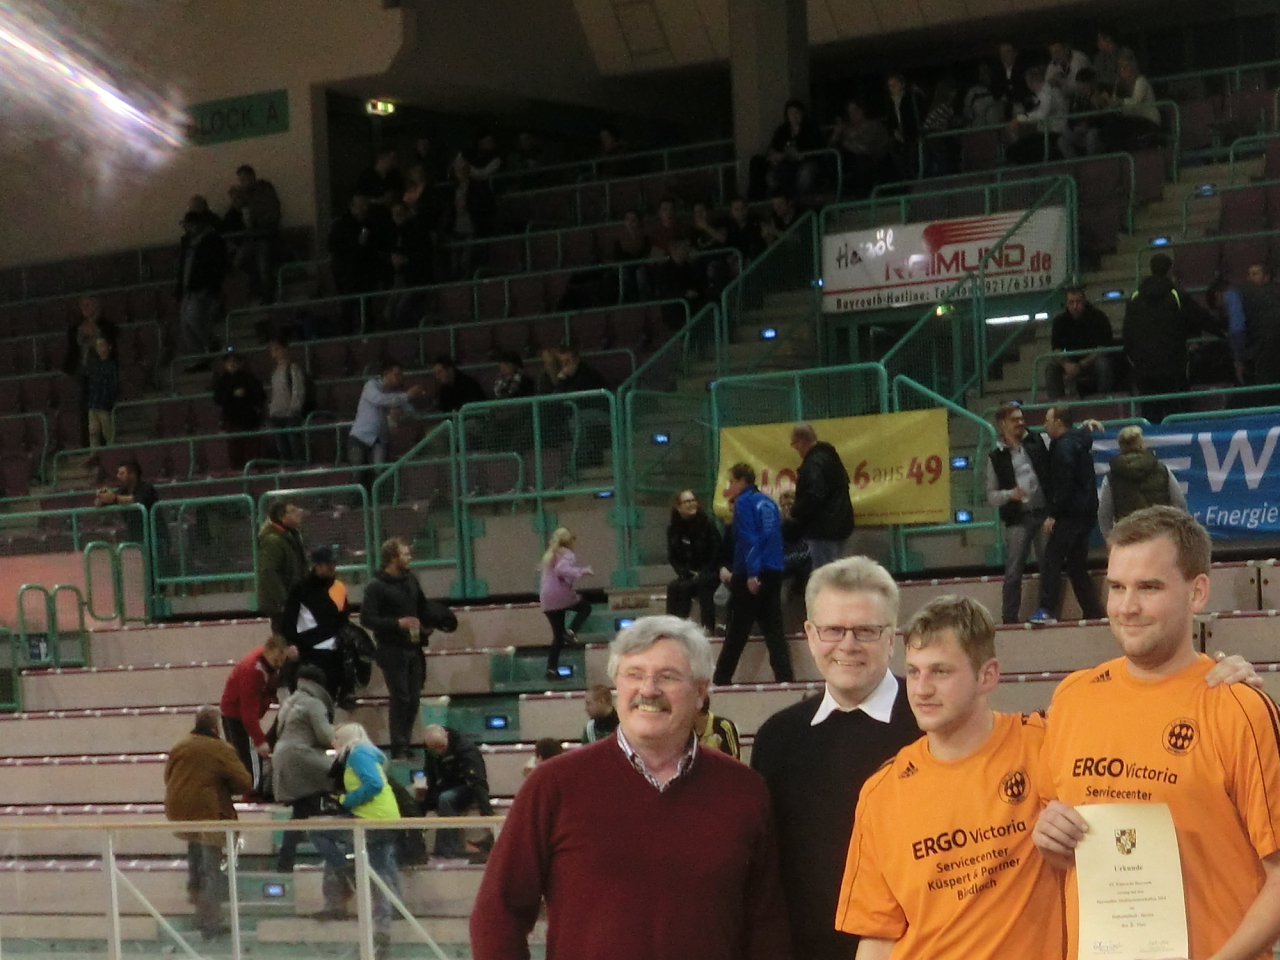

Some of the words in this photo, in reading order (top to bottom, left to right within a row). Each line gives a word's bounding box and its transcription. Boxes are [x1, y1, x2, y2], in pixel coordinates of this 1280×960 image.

[193, 103, 255, 137] LOCK
[1072, 757, 1125, 778] ERGO
[1126, 763, 1178, 785] Victoria
[1086, 785, 1153, 801] Servicecenter
[911, 829, 968, 861] ERGO
[969, 819, 1027, 844] Victoria
[927, 873, 971, 892] Küspert
[981, 858, 1020, 877] Partner
[936, 847, 1009, 873] Servicecenter
